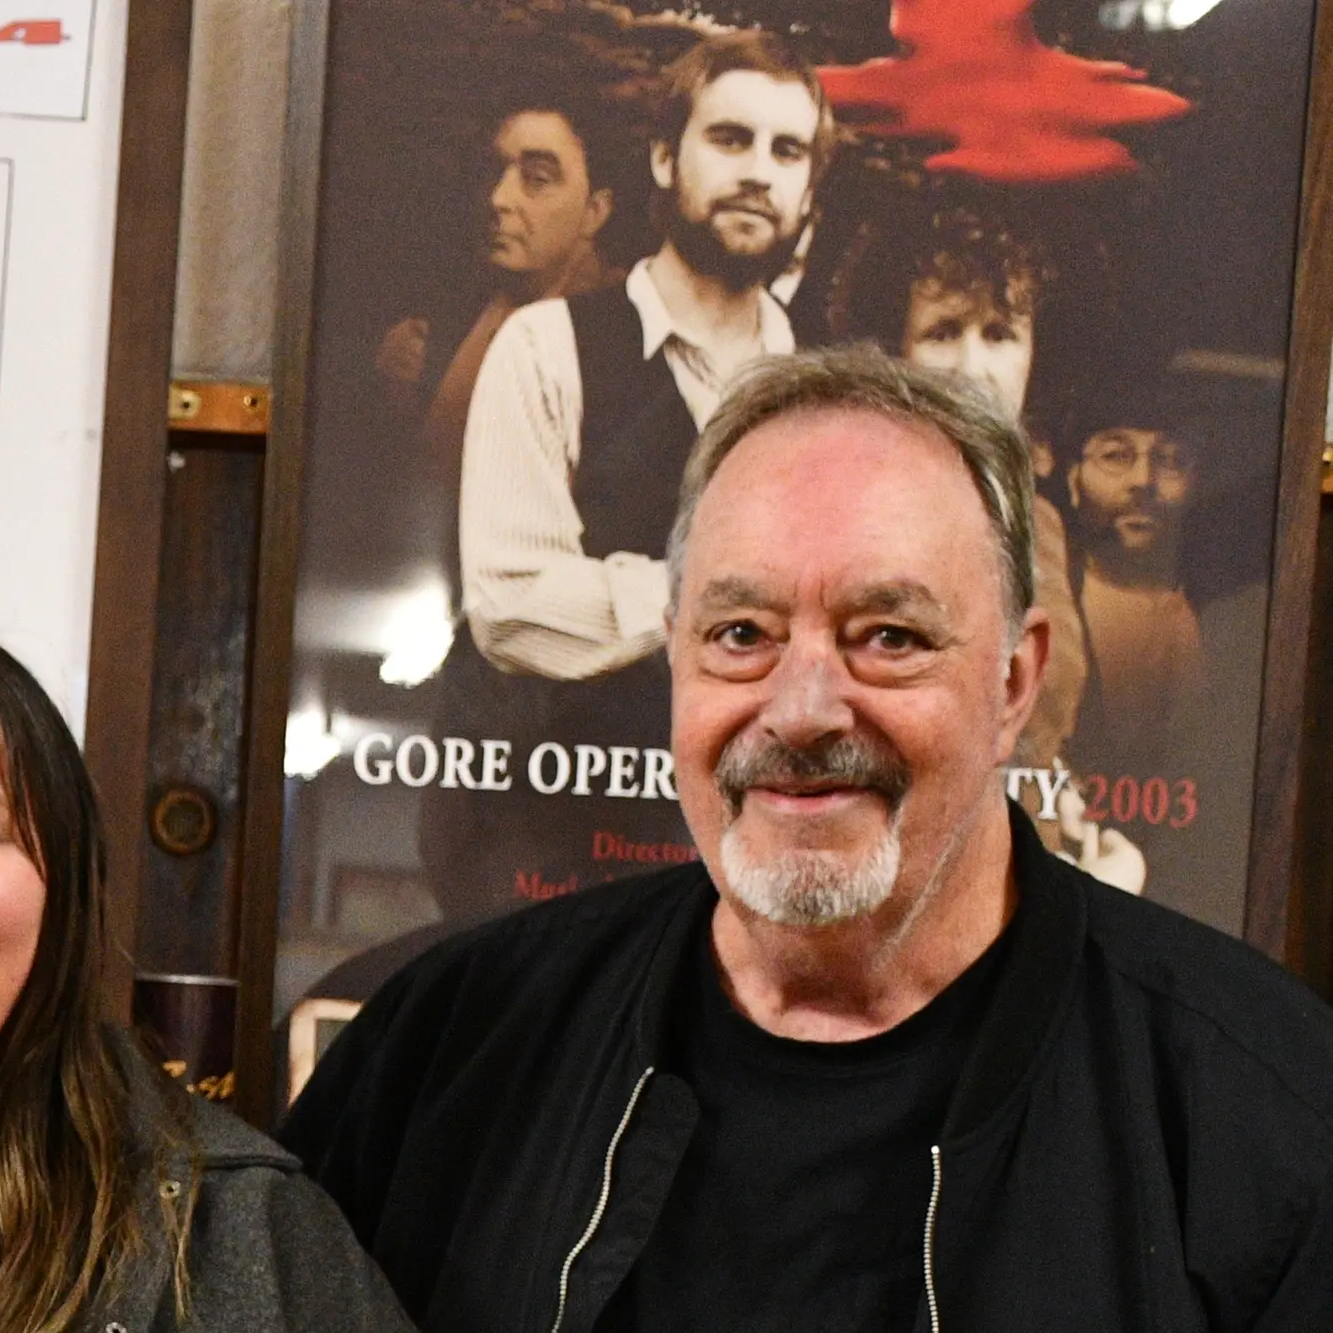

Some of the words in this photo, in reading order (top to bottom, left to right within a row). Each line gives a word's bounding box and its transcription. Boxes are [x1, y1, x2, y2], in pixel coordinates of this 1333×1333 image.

[354, 732, 513, 792] GORE
[527, 743, 680, 801] OPER
[1083, 774, 1199, 829] 2003
